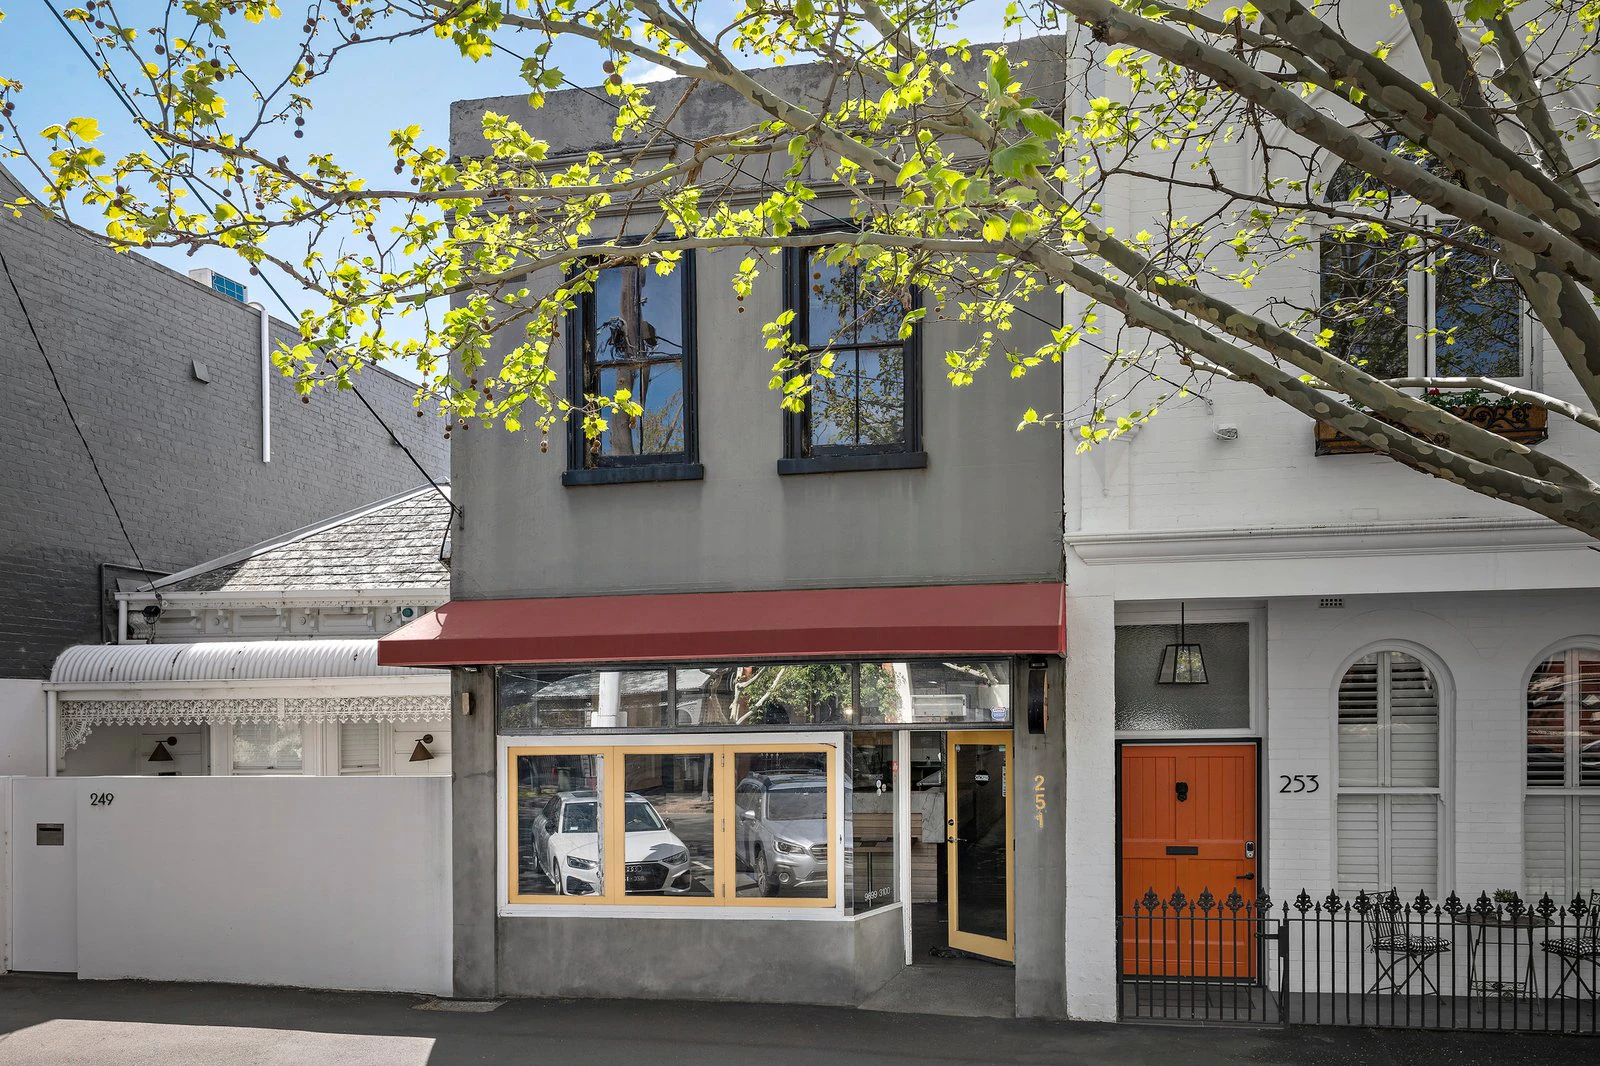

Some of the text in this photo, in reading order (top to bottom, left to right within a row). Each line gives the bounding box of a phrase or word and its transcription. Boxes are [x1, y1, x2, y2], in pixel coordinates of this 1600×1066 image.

[1280, 775, 1319, 793] 253
[90, 792, 115, 806] 249
[1034, 775, 1046, 828] 251
